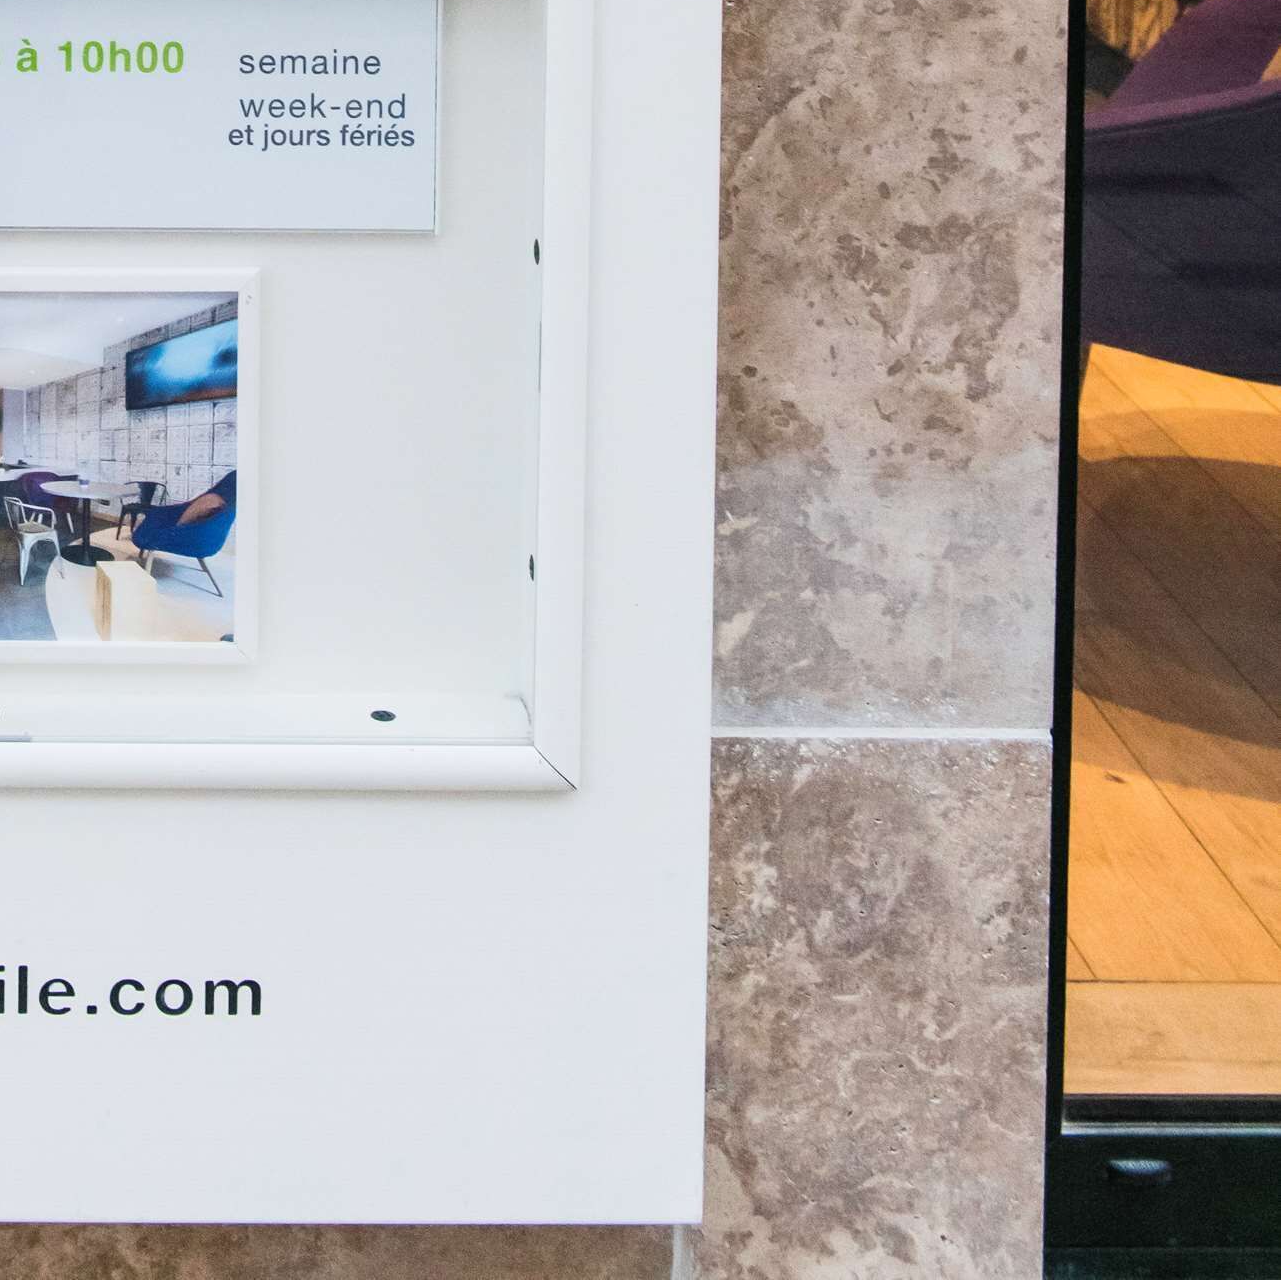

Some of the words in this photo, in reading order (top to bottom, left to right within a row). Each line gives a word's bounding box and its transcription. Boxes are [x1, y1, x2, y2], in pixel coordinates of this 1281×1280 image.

[18, 40, 39, 73] à
[59, 42, 184, 74] 10h00
[241, 50, 381, 75] semaine
[241, 94, 406, 120] week-end
[230, 126, 254, 146] et
[263, 125, 331, 152] jours
[341, 125, 415, 147] fériés
